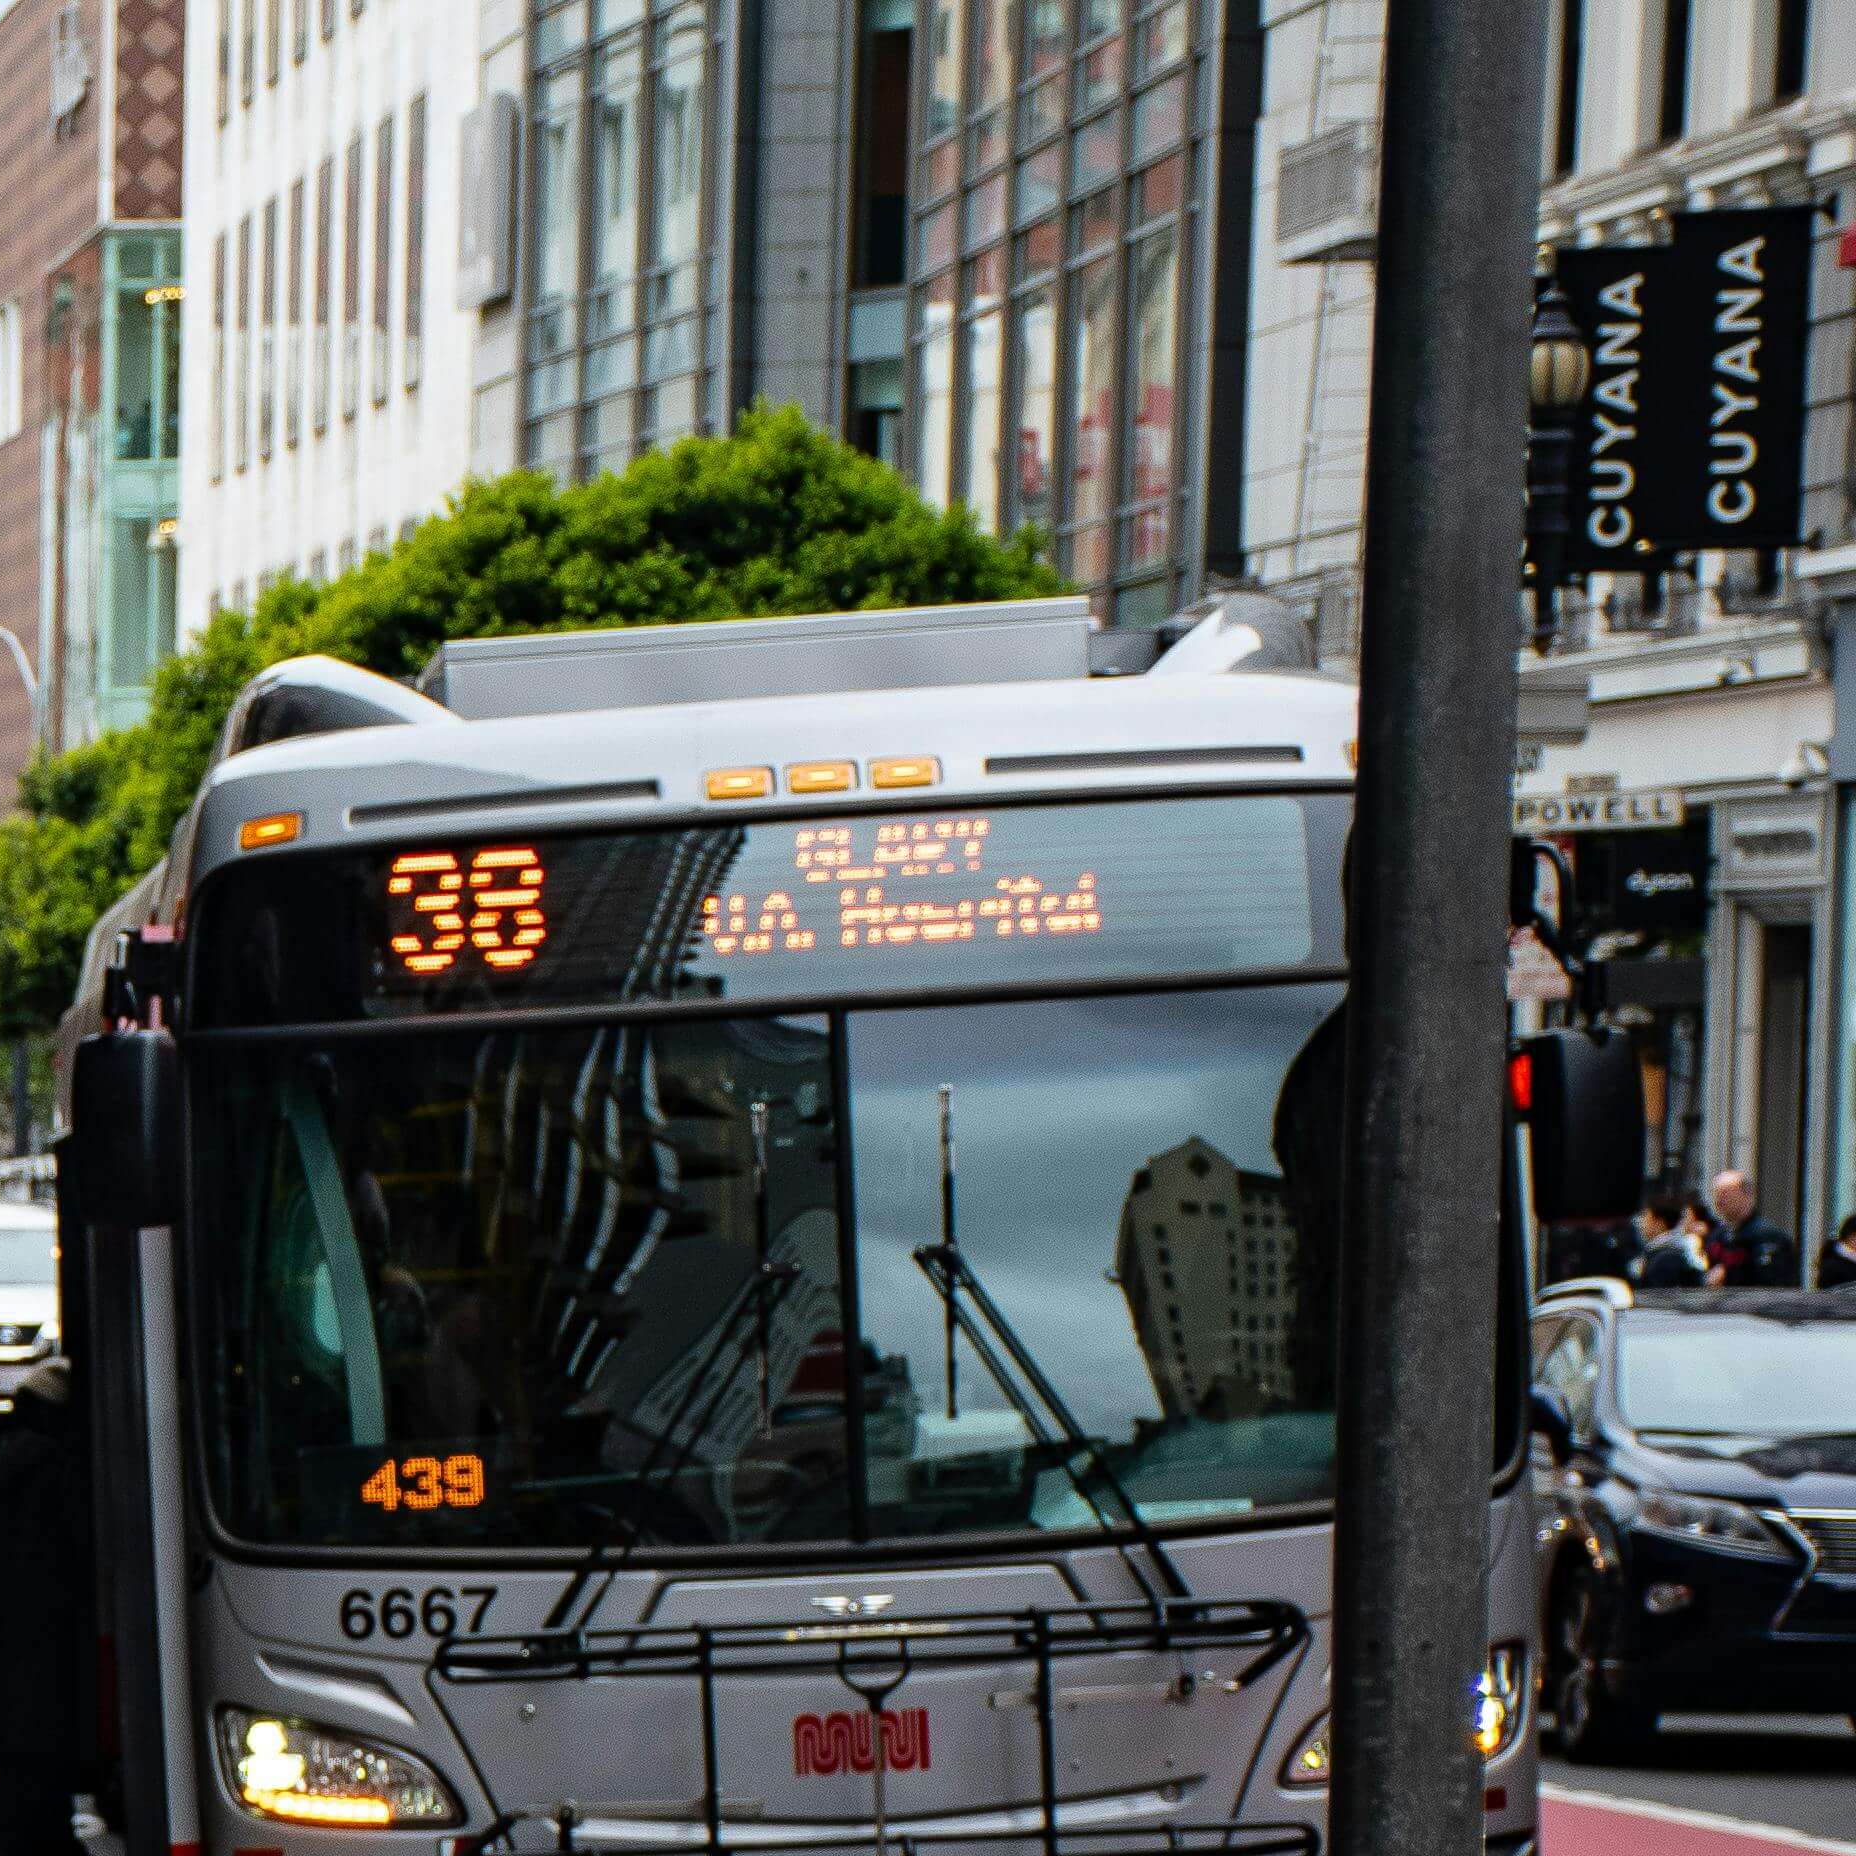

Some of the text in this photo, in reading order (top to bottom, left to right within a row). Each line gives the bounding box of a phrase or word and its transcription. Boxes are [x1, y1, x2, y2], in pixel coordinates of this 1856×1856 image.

[1588, 271, 1646, 548] CUYANA
[1706, 236, 1767, 524] CUYANA
[388, 846, 547, 974] 38
[361, 1453, 487, 1512] 439
[338, 1587, 499, 1642] 6667
